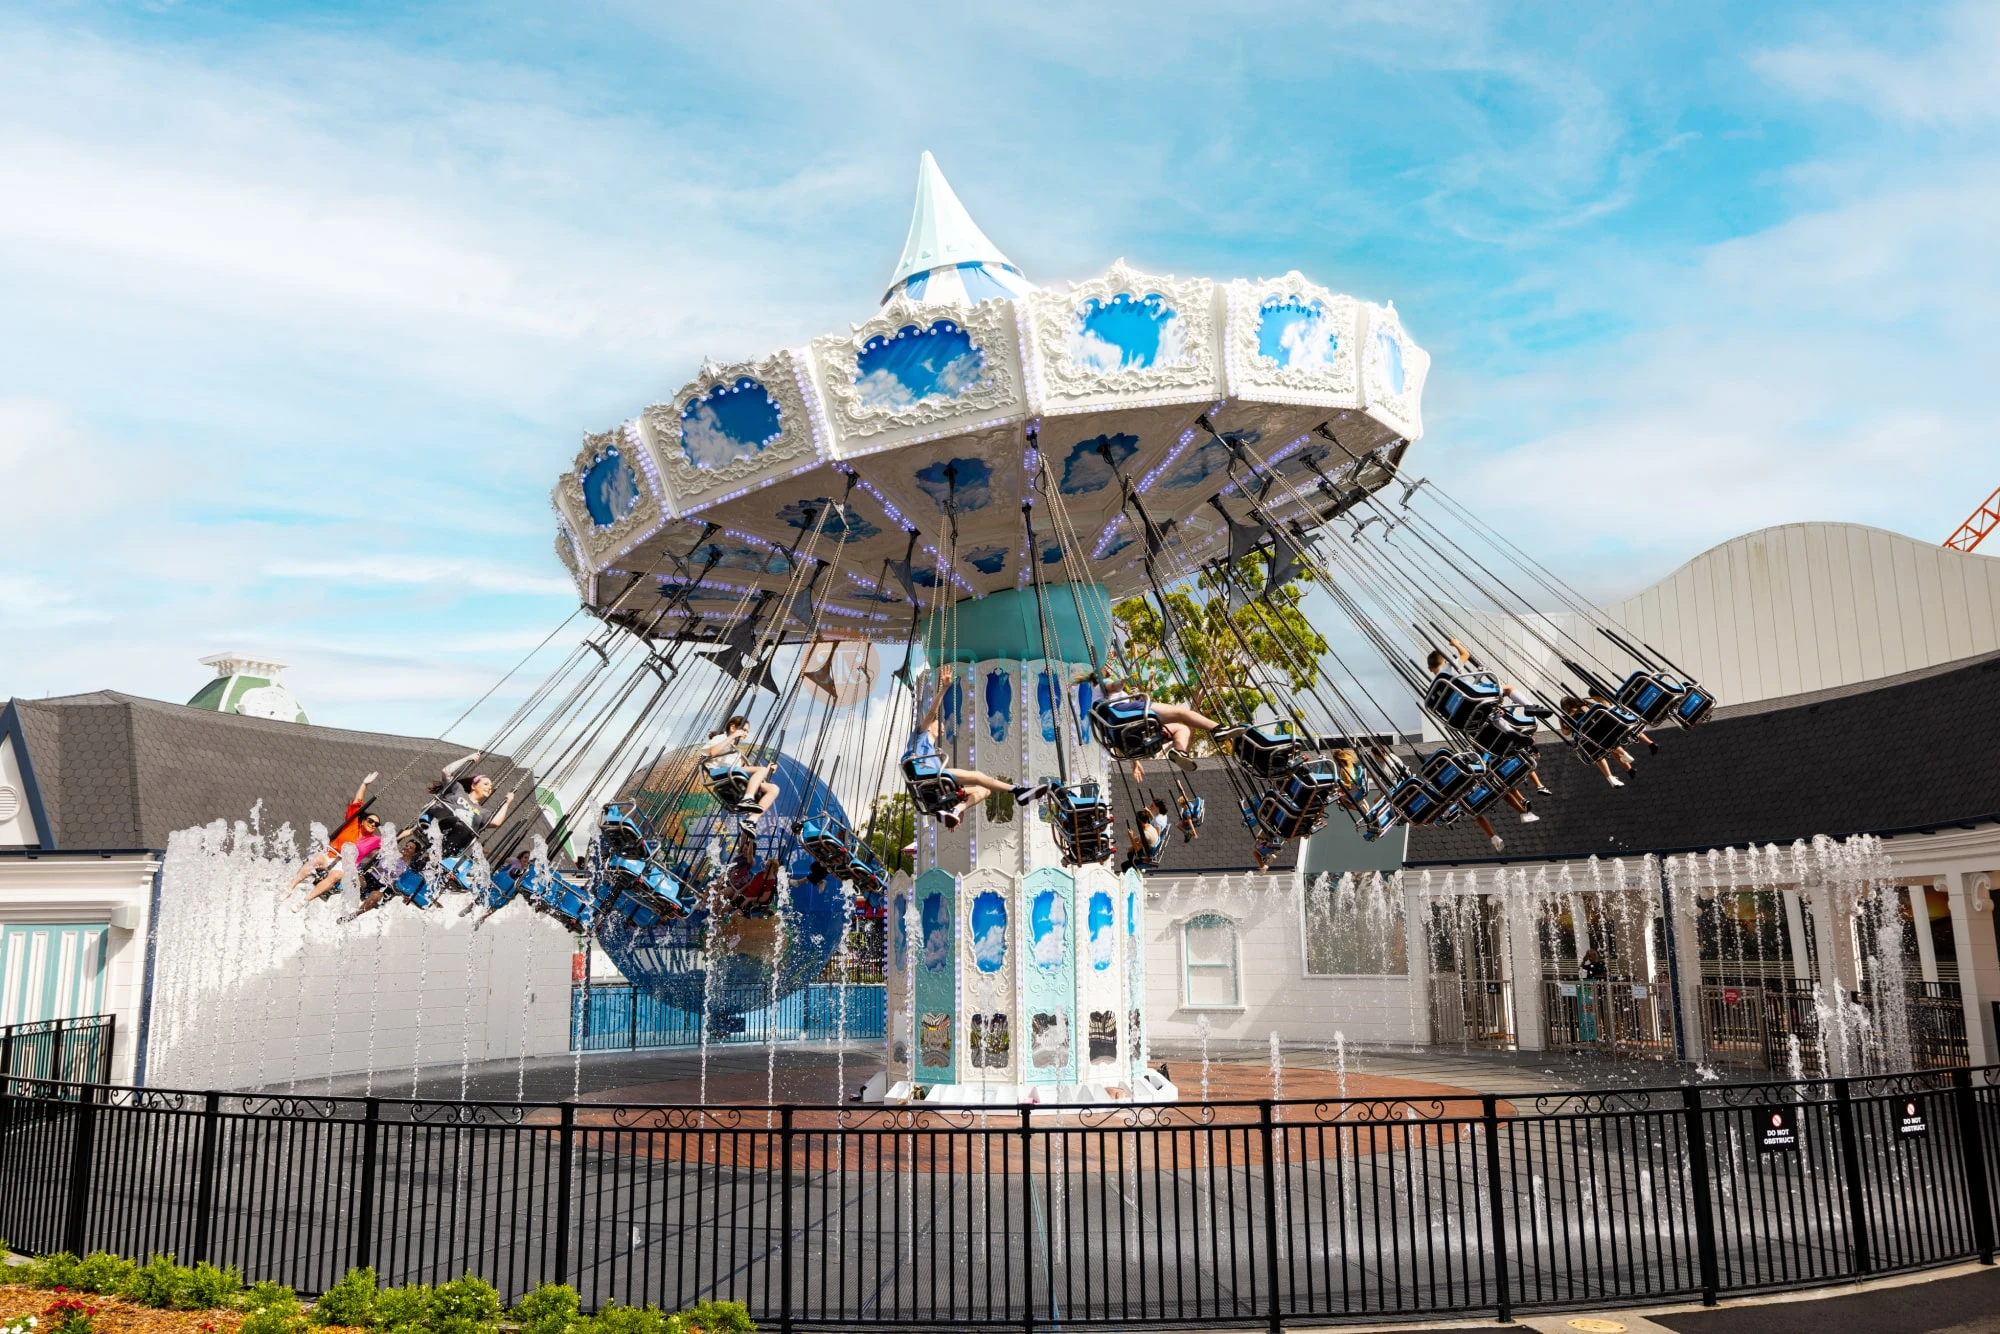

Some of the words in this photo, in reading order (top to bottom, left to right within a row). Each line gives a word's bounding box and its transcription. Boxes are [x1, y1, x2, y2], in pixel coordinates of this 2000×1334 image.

[1777, 1128, 1789, 1136] NOT
[1901, 1124, 1926, 1133] OBSTRUCT
[1763, 1136, 1795, 1145] OBSTRUCT
